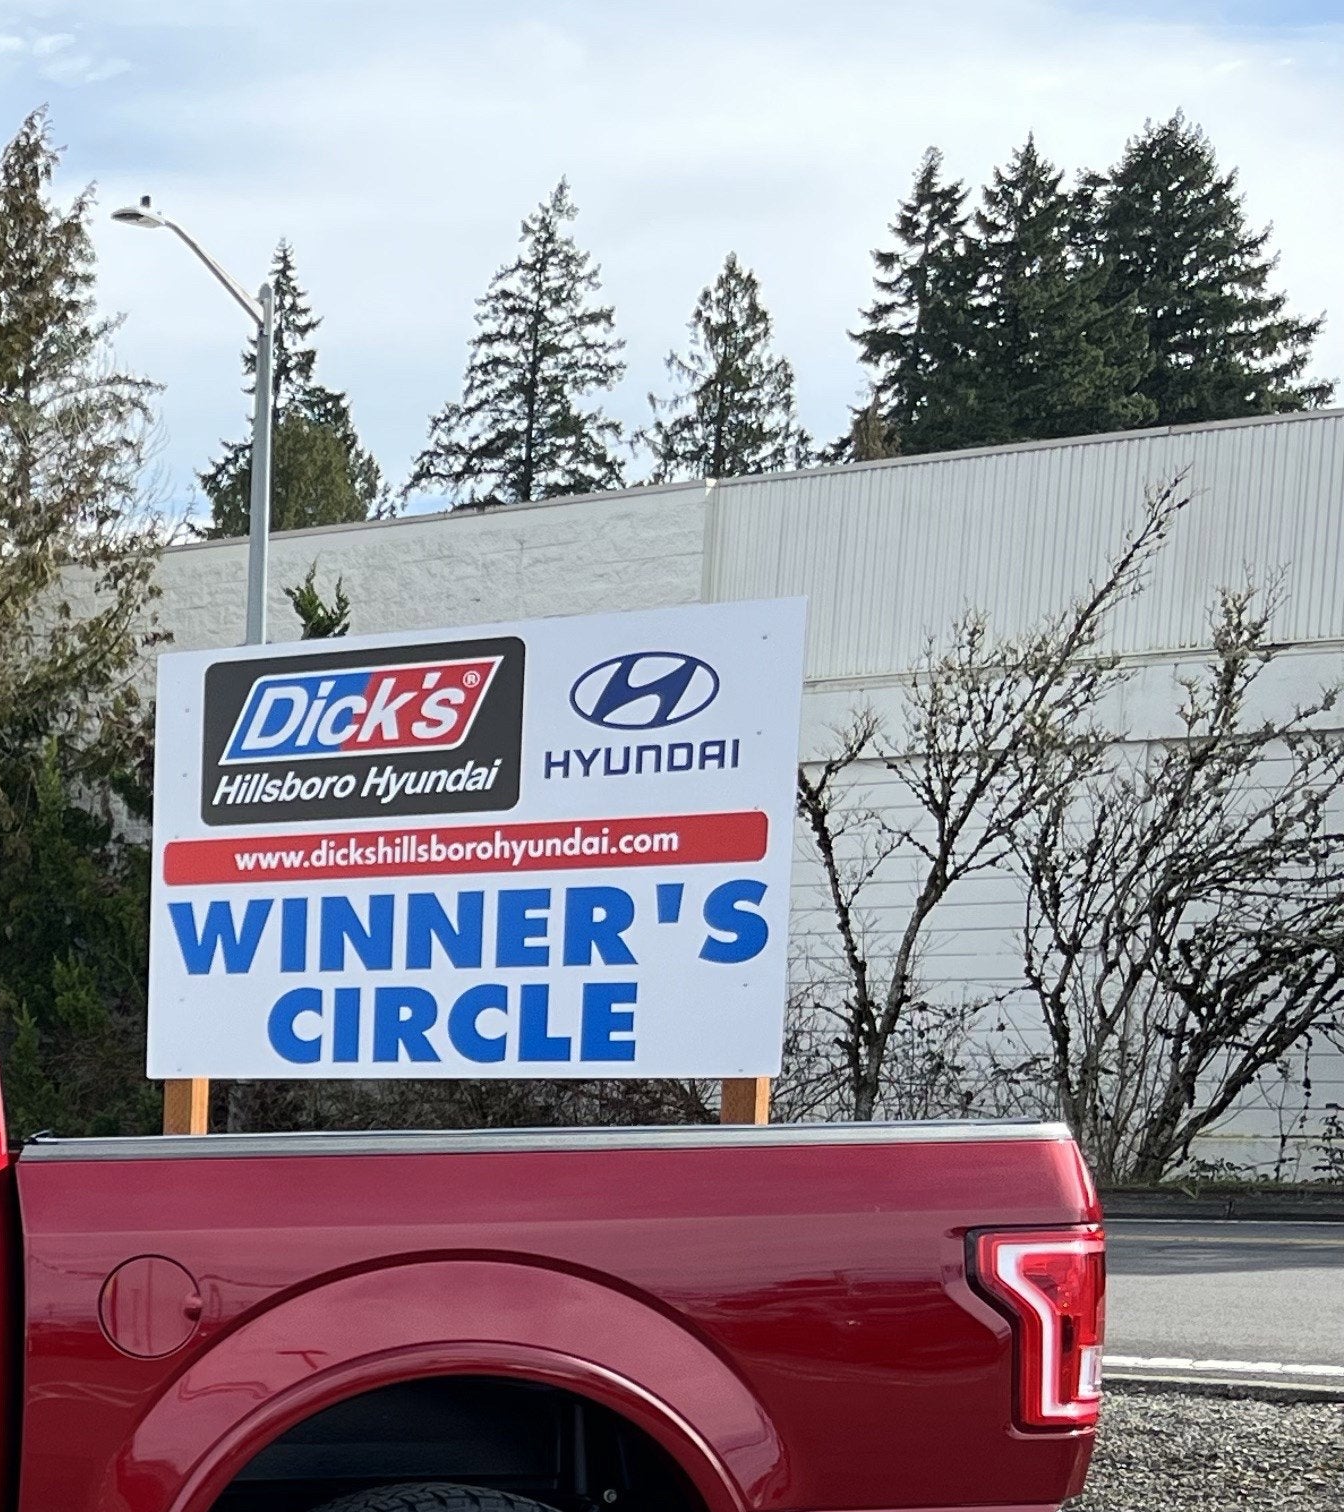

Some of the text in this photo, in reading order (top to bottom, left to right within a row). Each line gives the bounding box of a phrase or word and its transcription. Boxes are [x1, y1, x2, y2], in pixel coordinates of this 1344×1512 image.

[212, 759, 503, 806] Hillsboro Hyundai
[543, 739, 740, 779] HYUNDAI
[234, 829, 679, 872] www.dickshillsborohyundai.com
[167, 879, 770, 975] WINNER'S
[267, 981, 639, 1064] CIRCLE
